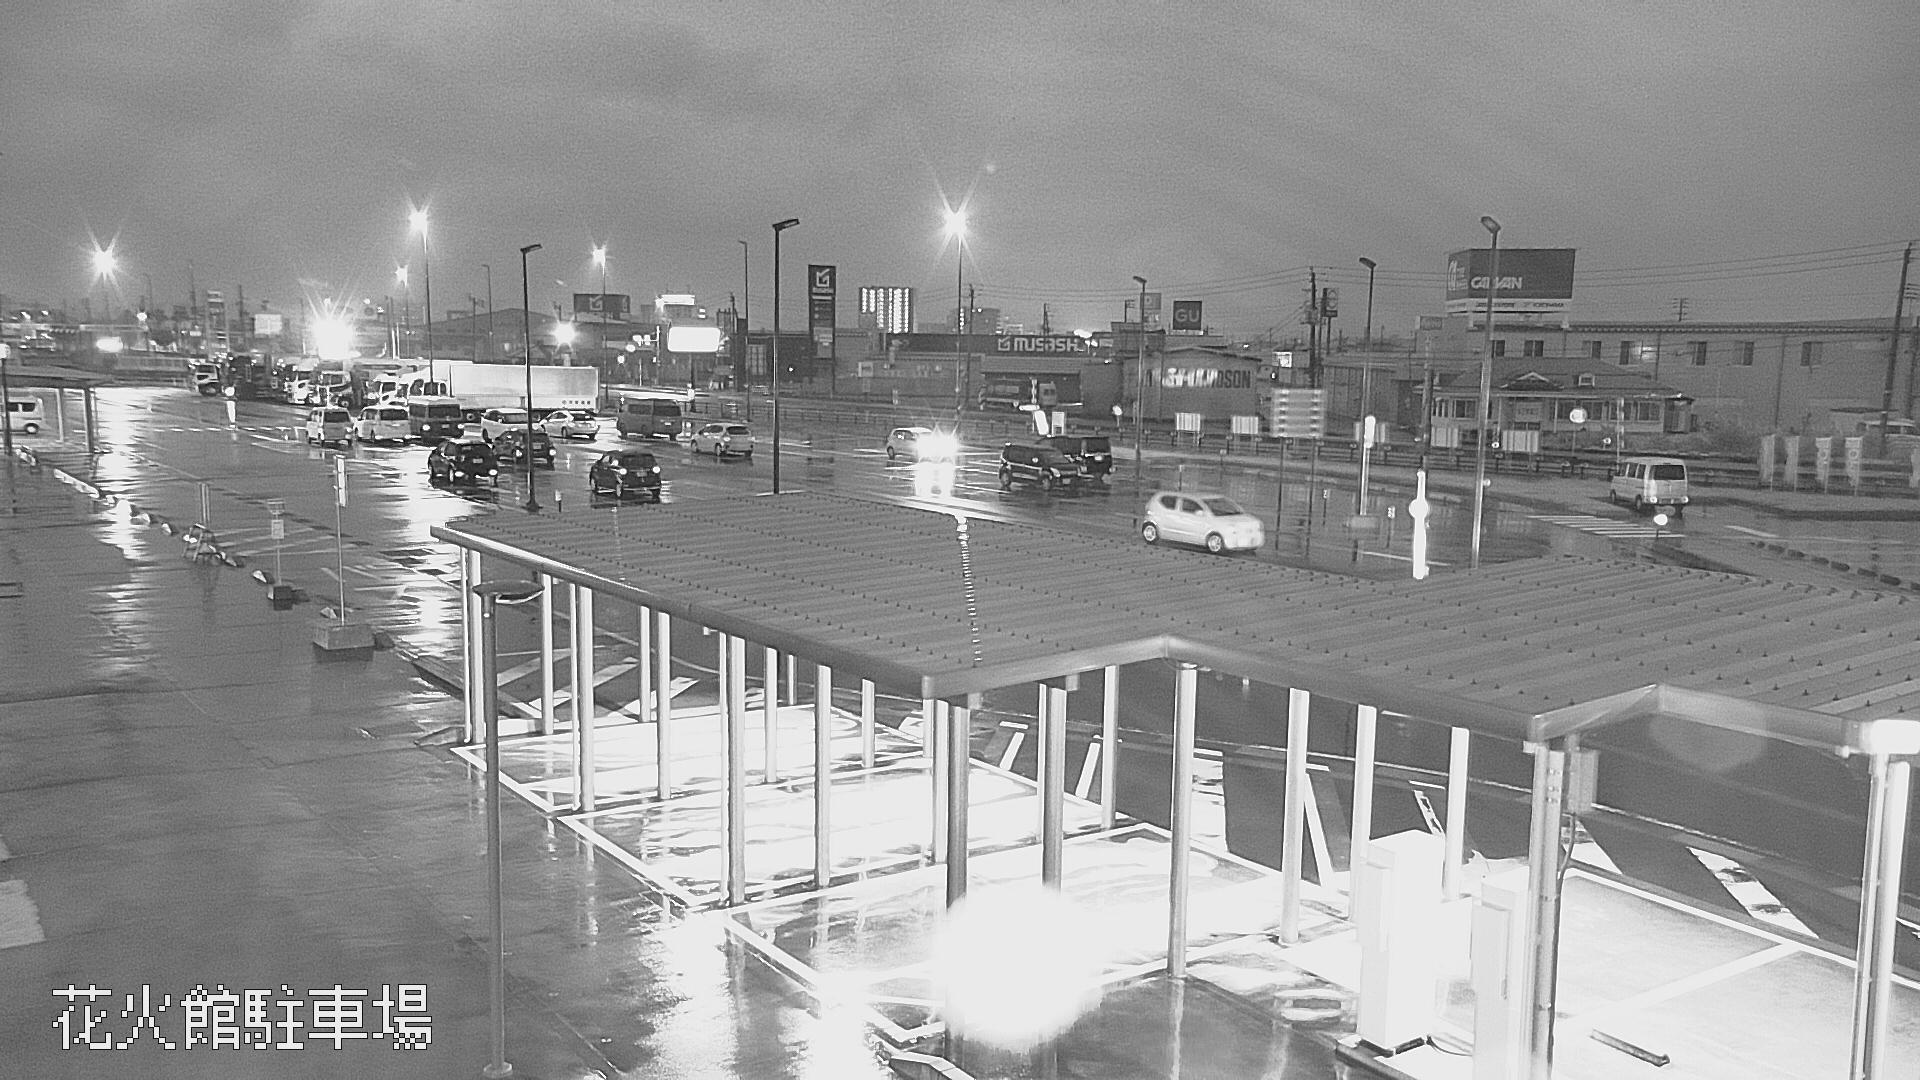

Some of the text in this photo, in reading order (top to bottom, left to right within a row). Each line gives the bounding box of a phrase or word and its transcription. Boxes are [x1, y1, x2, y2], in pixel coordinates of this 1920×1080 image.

[1471, 277, 1522, 289] CAVAN
[1174, 309, 1199, 323] GU
[1014, 337, 1084, 351] MUSASH
